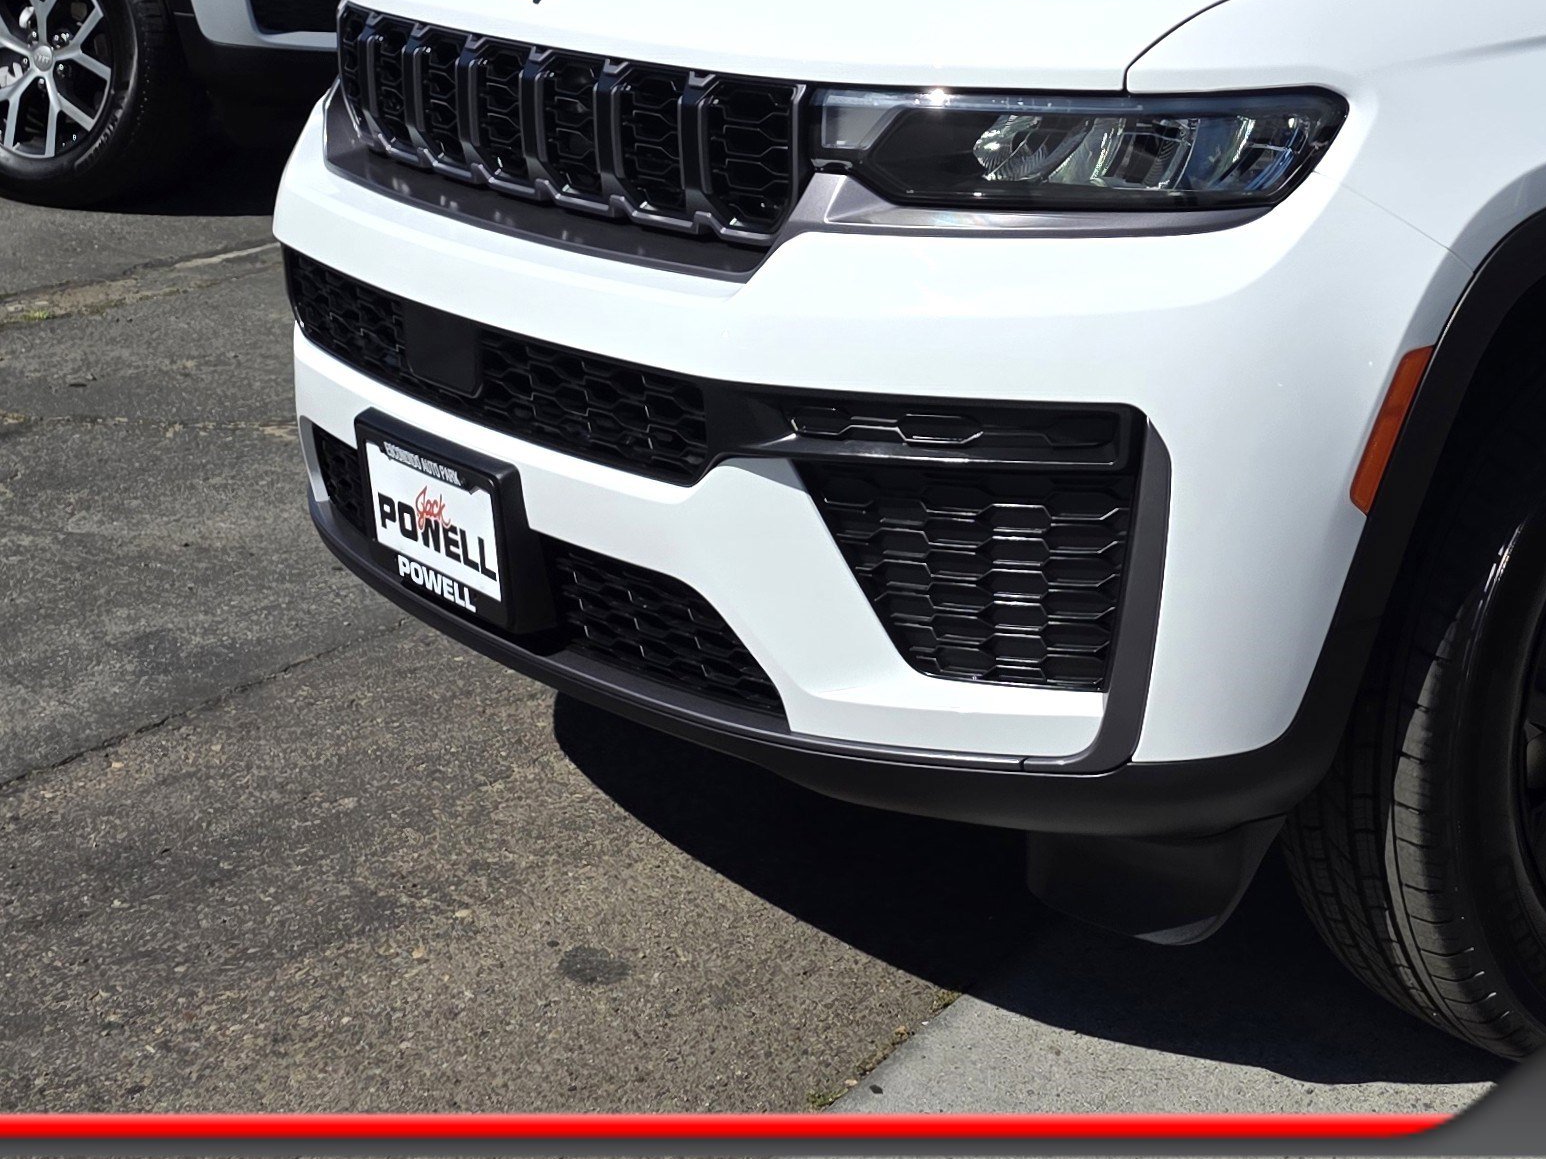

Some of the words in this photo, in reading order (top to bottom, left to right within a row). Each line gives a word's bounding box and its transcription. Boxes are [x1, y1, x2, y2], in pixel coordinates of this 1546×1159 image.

[421, 457, 441, 478] AUTO
[438, 464, 462, 486] PARK
[415, 485, 451, 530] Jack
[377, 492, 497, 582] POWELL
[397, 554, 477, 613] POWELL
